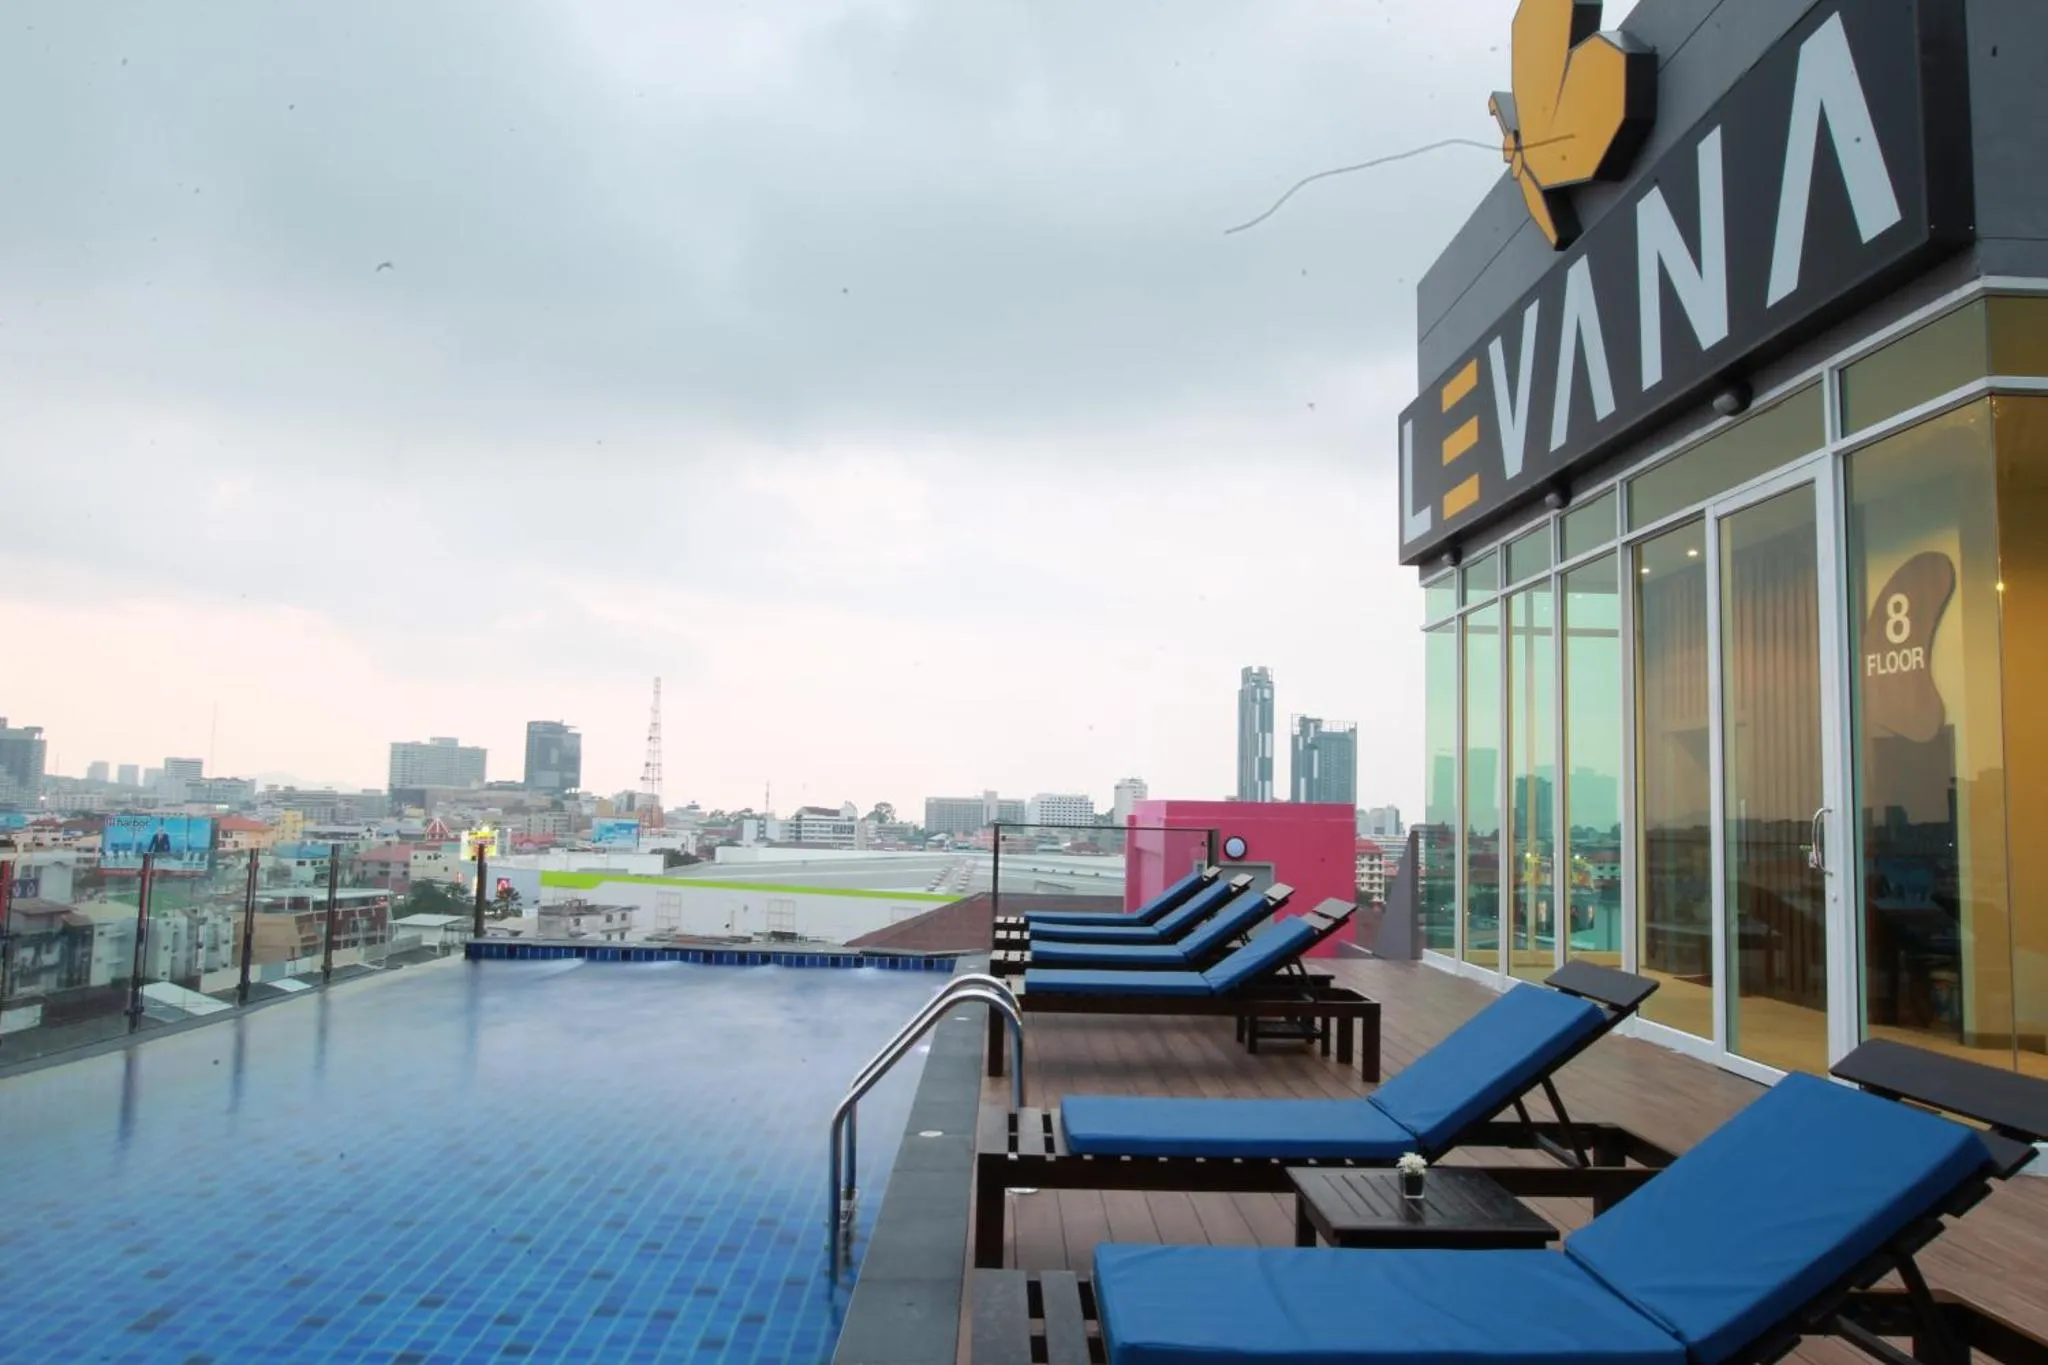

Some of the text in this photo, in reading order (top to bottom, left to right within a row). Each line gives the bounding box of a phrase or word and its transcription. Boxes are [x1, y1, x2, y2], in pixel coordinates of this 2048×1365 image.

[1404, 11, 1902, 543] LEVANA
[1885, 593, 1911, 644] 8
[1866, 646, 1925, 677] FLOOR
